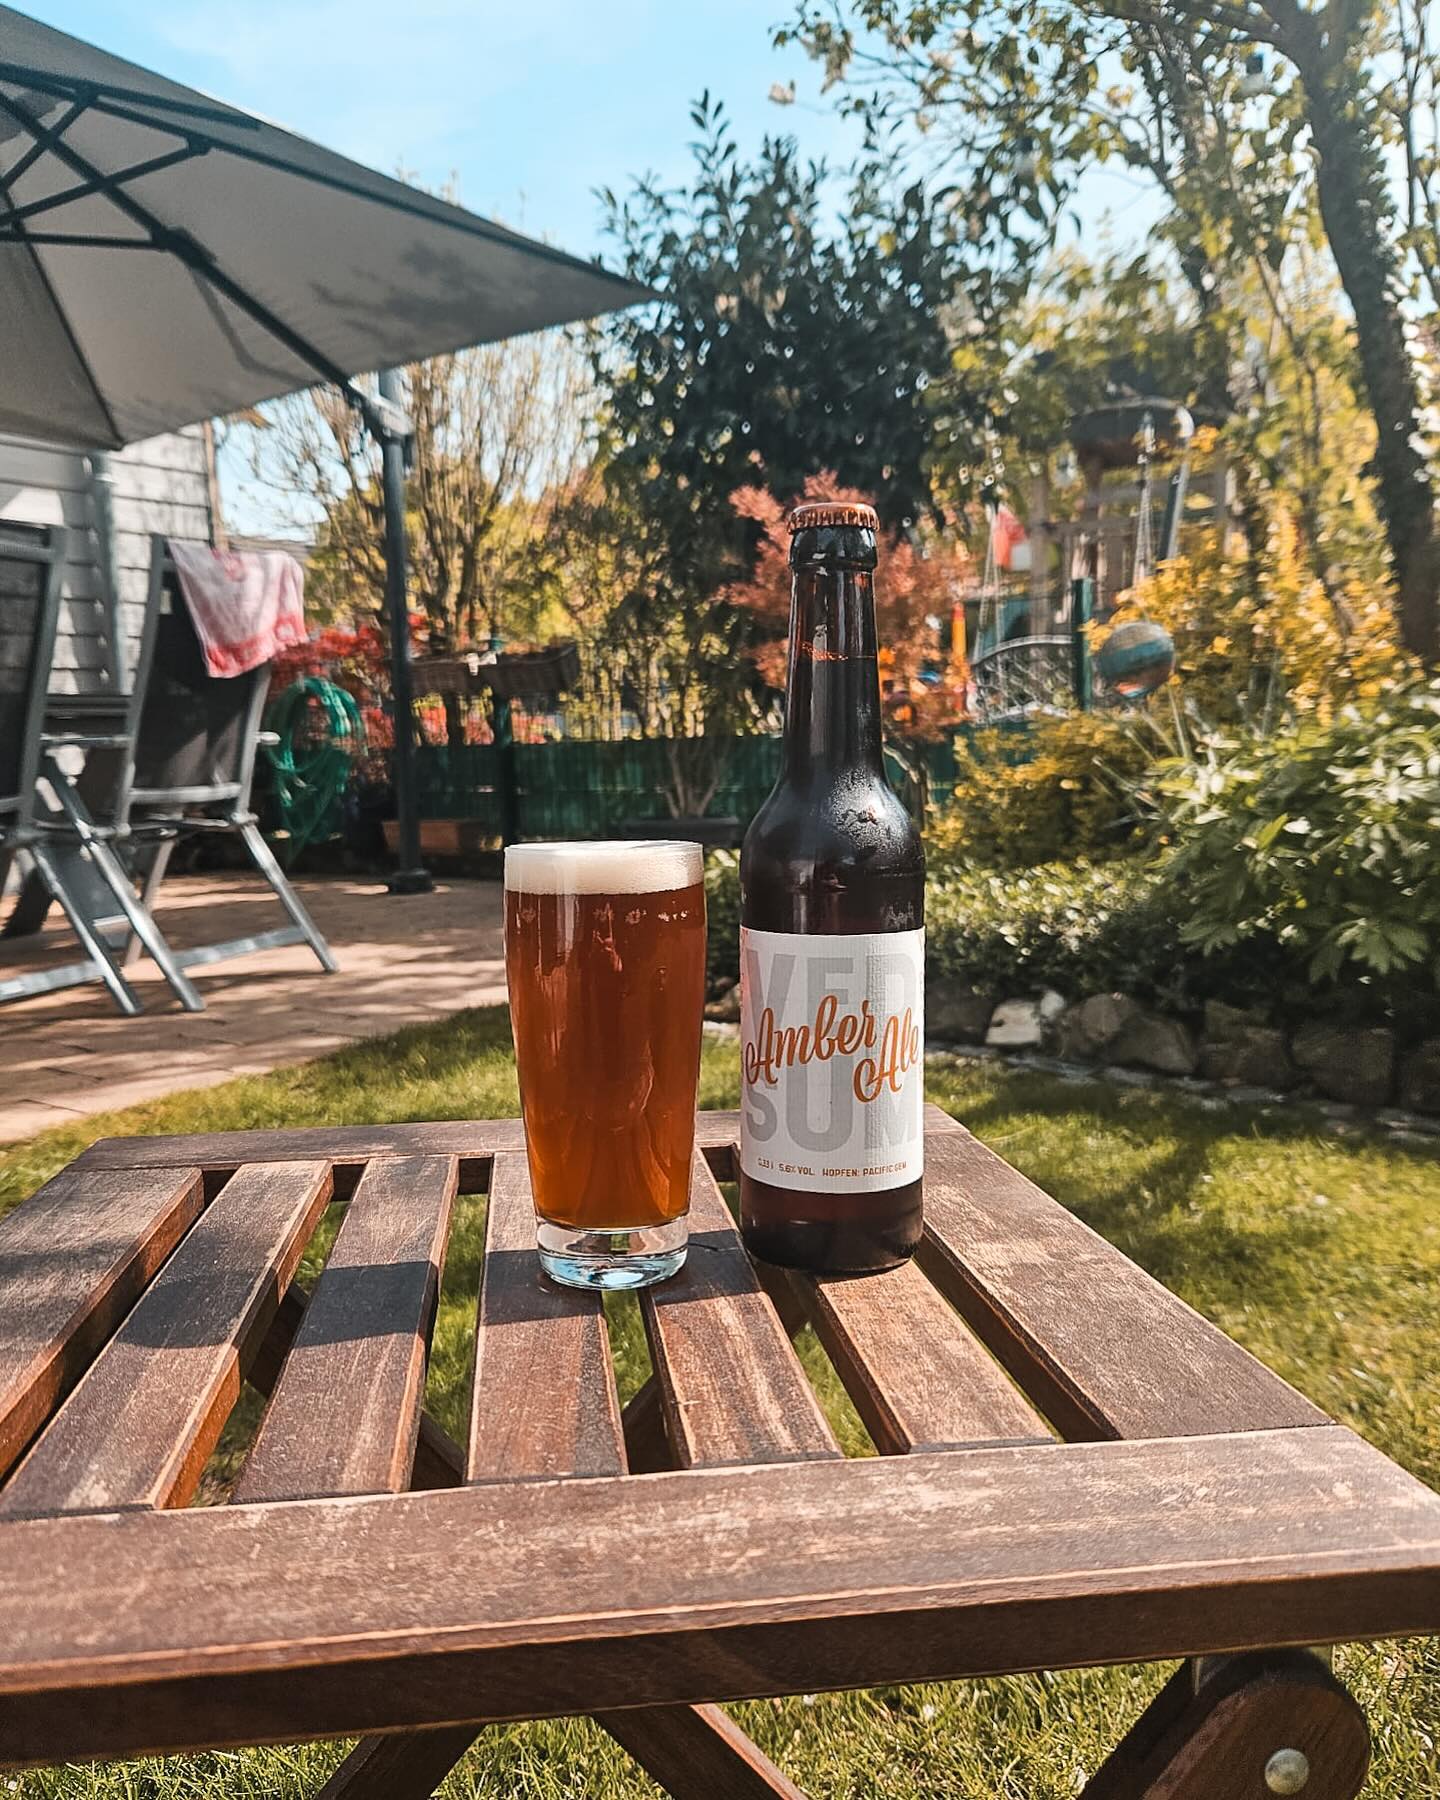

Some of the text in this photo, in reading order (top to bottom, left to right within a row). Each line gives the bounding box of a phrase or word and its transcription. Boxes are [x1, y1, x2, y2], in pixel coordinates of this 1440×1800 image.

[745, 995, 919, 1103] Amber Ale
[822, 1167, 860, 1177] HOPFEN:
[862, 1164, 894, 1177] PACIFIC
